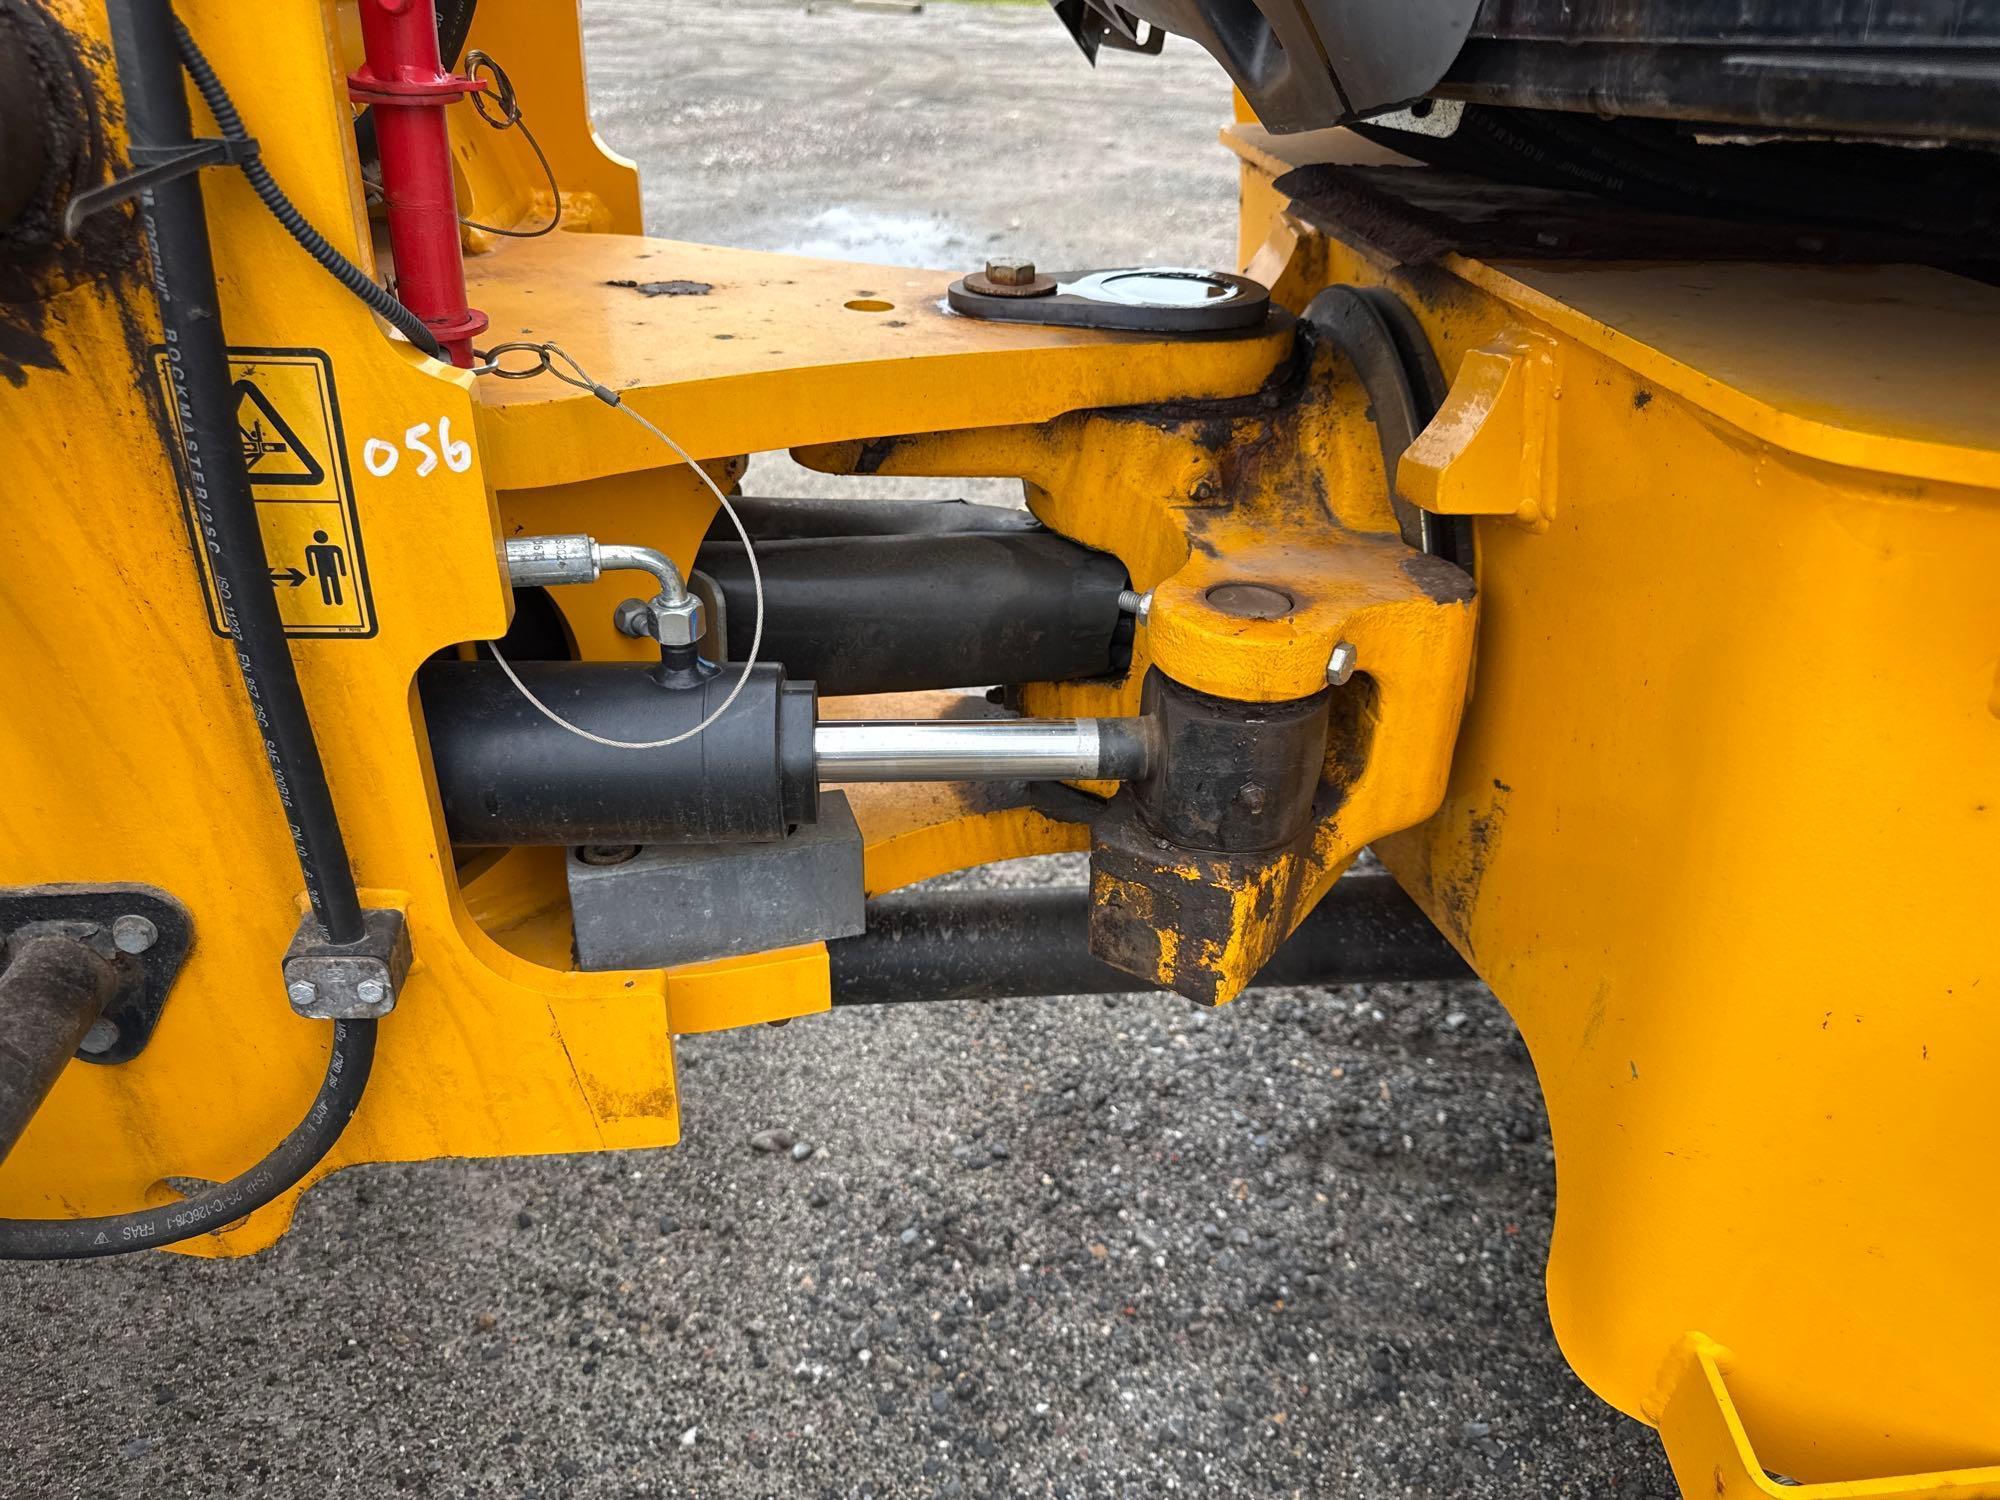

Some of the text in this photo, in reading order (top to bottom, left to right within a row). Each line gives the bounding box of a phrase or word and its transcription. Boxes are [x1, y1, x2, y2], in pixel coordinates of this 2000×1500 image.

[363, 415, 472, 477] 056
[165, 328, 222, 555] ROCKMASTER/2SC
[216, 575, 232, 600] ISO
[238, 652, 252, 673] EN
[264, 740, 281, 765] SAE
[122, 1221, 156, 1241] FRAS
